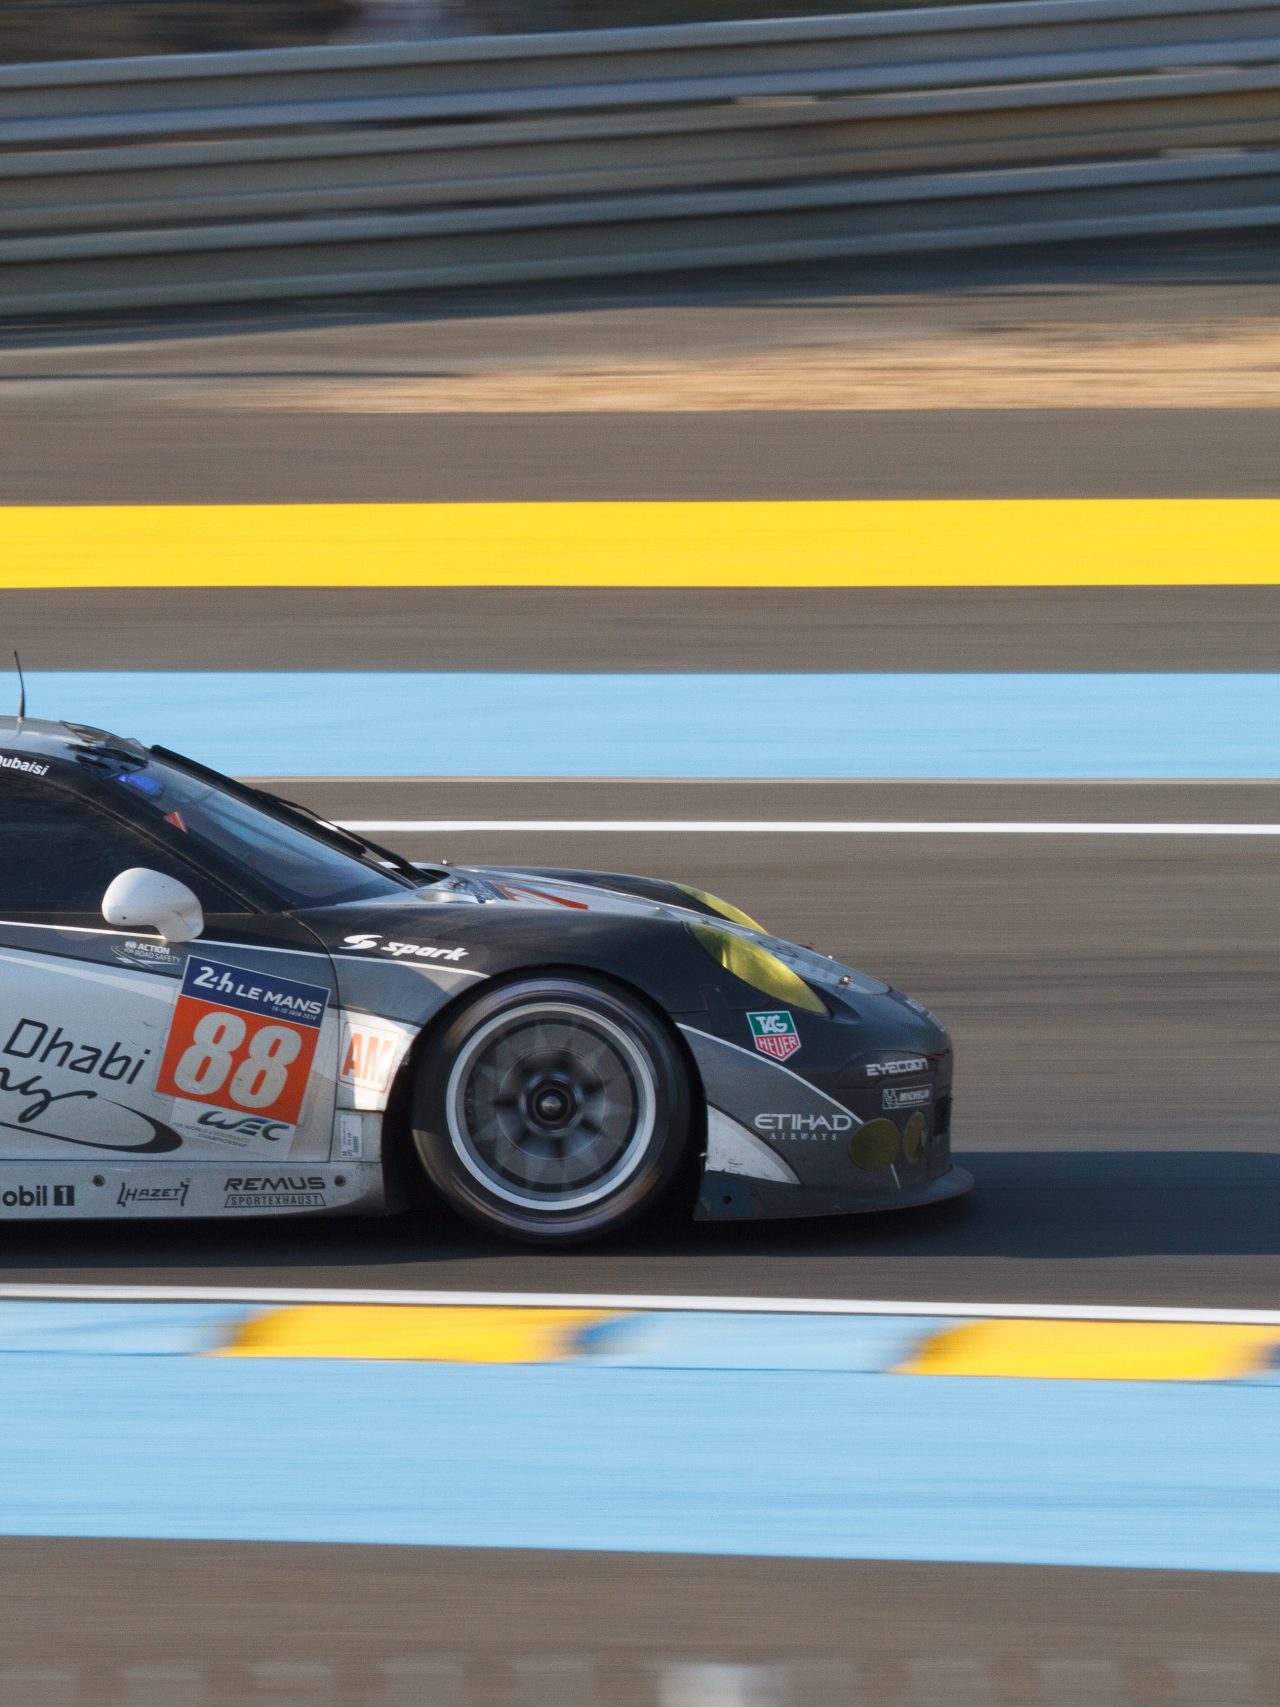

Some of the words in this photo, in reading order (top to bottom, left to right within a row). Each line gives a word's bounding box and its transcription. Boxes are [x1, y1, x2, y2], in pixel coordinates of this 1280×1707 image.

[138, 943, 170, 954] ACTION
[381, 942, 470, 961] spark
[235, 984, 263, 1000] LE
[262, 990, 323, 1016] MANS
[755, 1015, 788, 1034] TAG
[2, 1018, 151, 1084] Dhabi
[757, 1036, 798, 1057] HEUER
[174, 1011, 302, 1109] 88
[342, 1032, 393, 1083] AM
[197, 1110, 290, 1142] WEC
[754, 1113, 852, 1131] ETIHAD
[769, 1132, 838, 1141] AIRWAYS
[223, 1177, 327, 1191] REMUS
[124, 1188, 182, 1201] HAZET
[231, 1195, 320, 1206] SPORTEXHAUST
